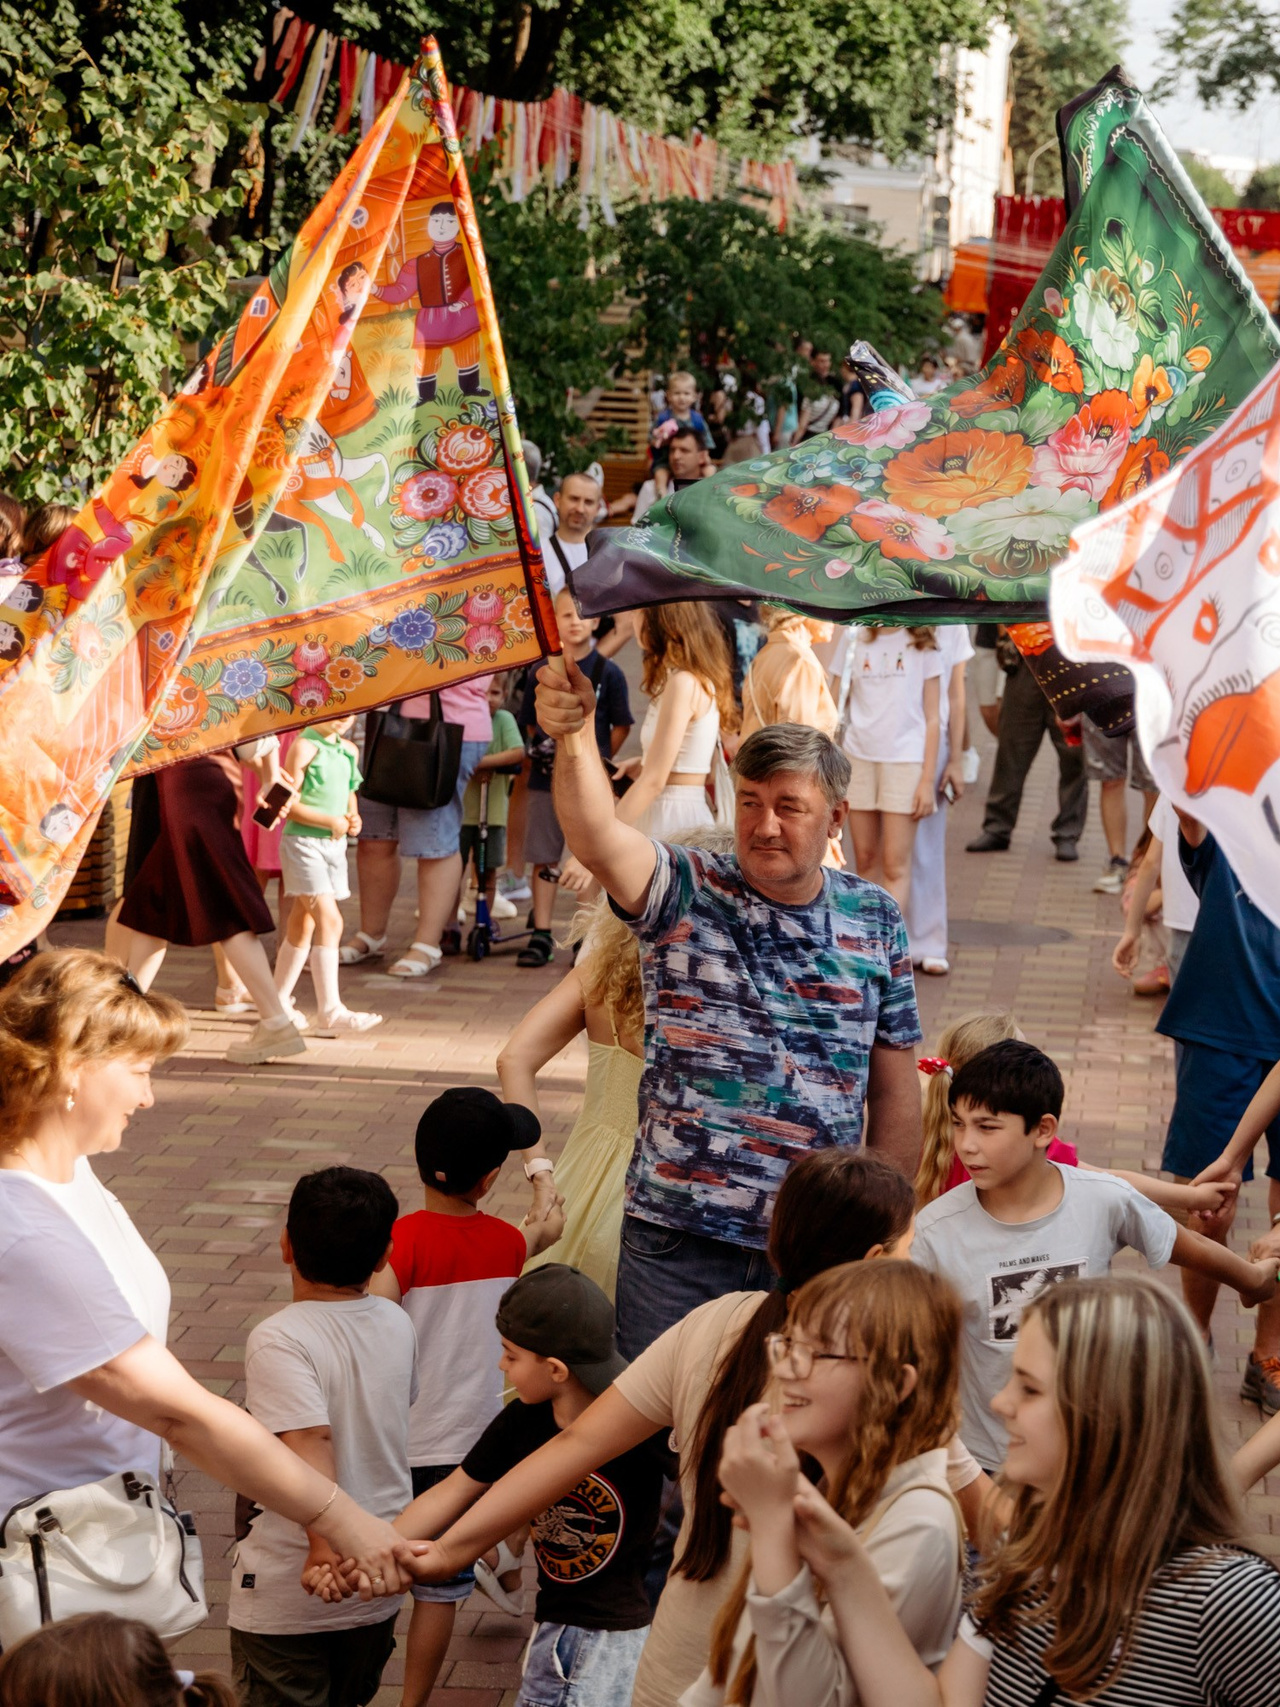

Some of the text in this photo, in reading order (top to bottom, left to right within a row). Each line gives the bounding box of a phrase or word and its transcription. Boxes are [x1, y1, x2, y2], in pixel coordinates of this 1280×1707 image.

[999, 1253, 1050, 1268] PALMS AND WAVES
